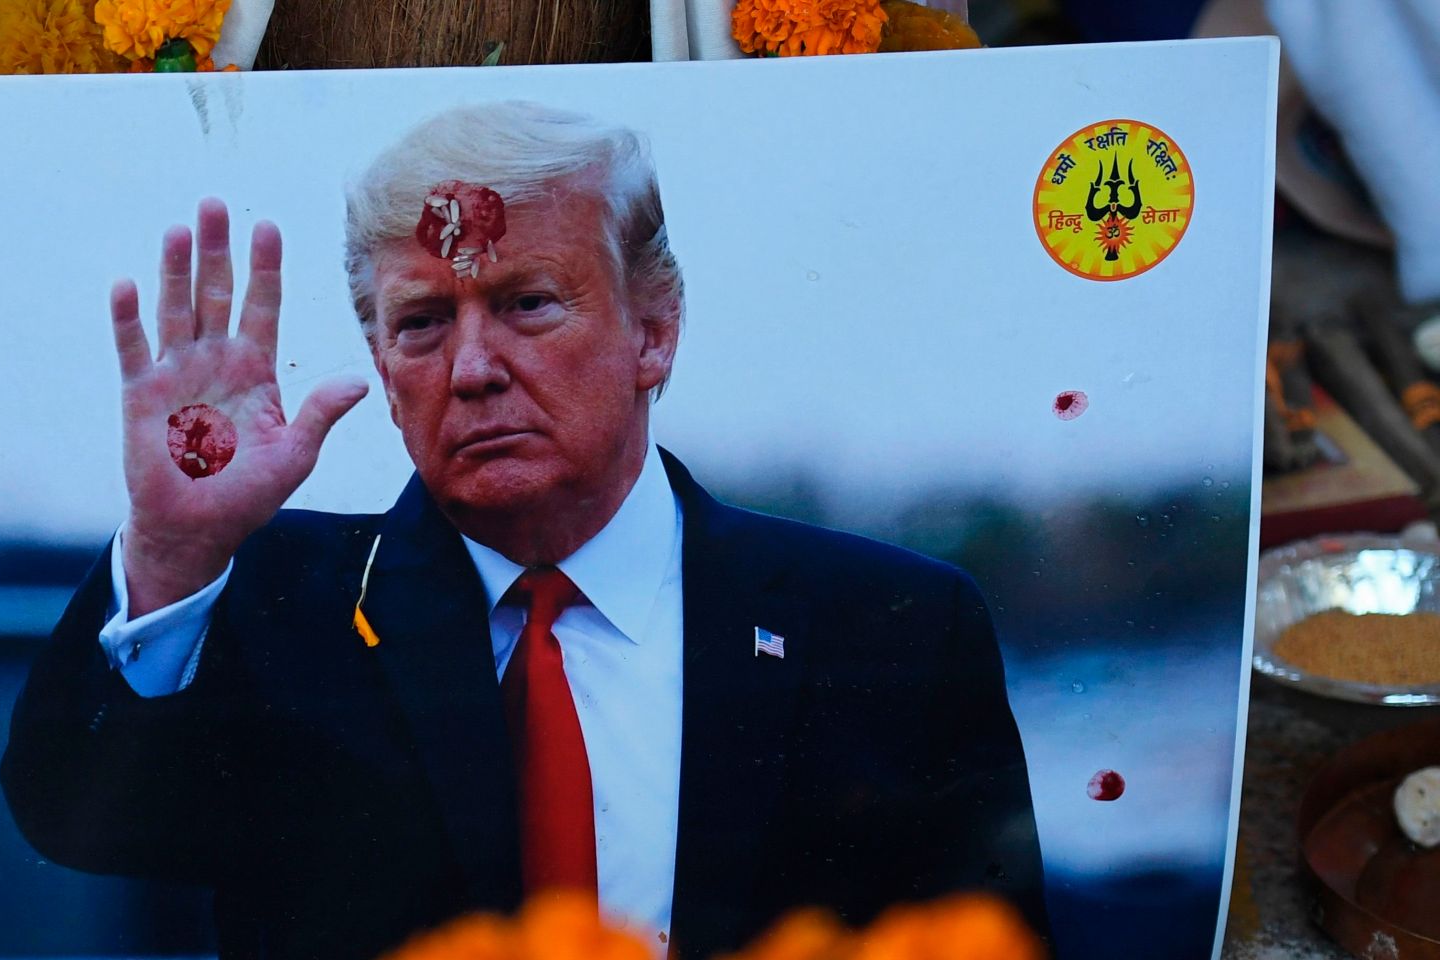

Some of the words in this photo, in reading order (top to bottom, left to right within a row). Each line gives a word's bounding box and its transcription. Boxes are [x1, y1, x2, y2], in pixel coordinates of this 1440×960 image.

[1084, 127, 1128, 151] रक्षति
[1048, 209, 1084, 234] हिन्दू
[1141, 206, 1180, 224] सेना
